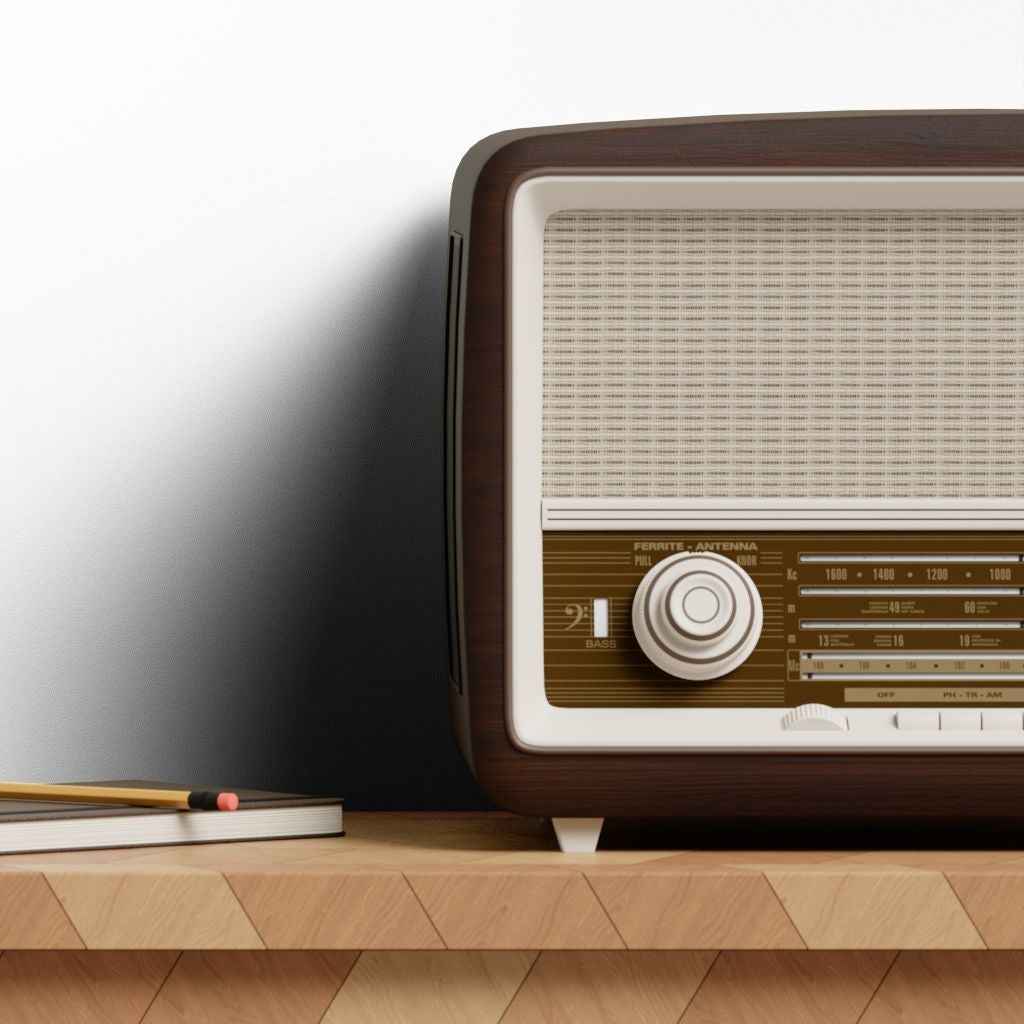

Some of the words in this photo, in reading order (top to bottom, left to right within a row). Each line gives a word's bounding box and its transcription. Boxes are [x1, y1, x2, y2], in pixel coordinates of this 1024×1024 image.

[633, 542, 685, 551] FERRITE
[695, 542, 758, 551] ANTENNA
[825, 568, 848, 581] 1600
[873, 568, 895, 581] 1400
[926, 568, 949, 581] 1200
[585, 639, 617, 649] BASS
